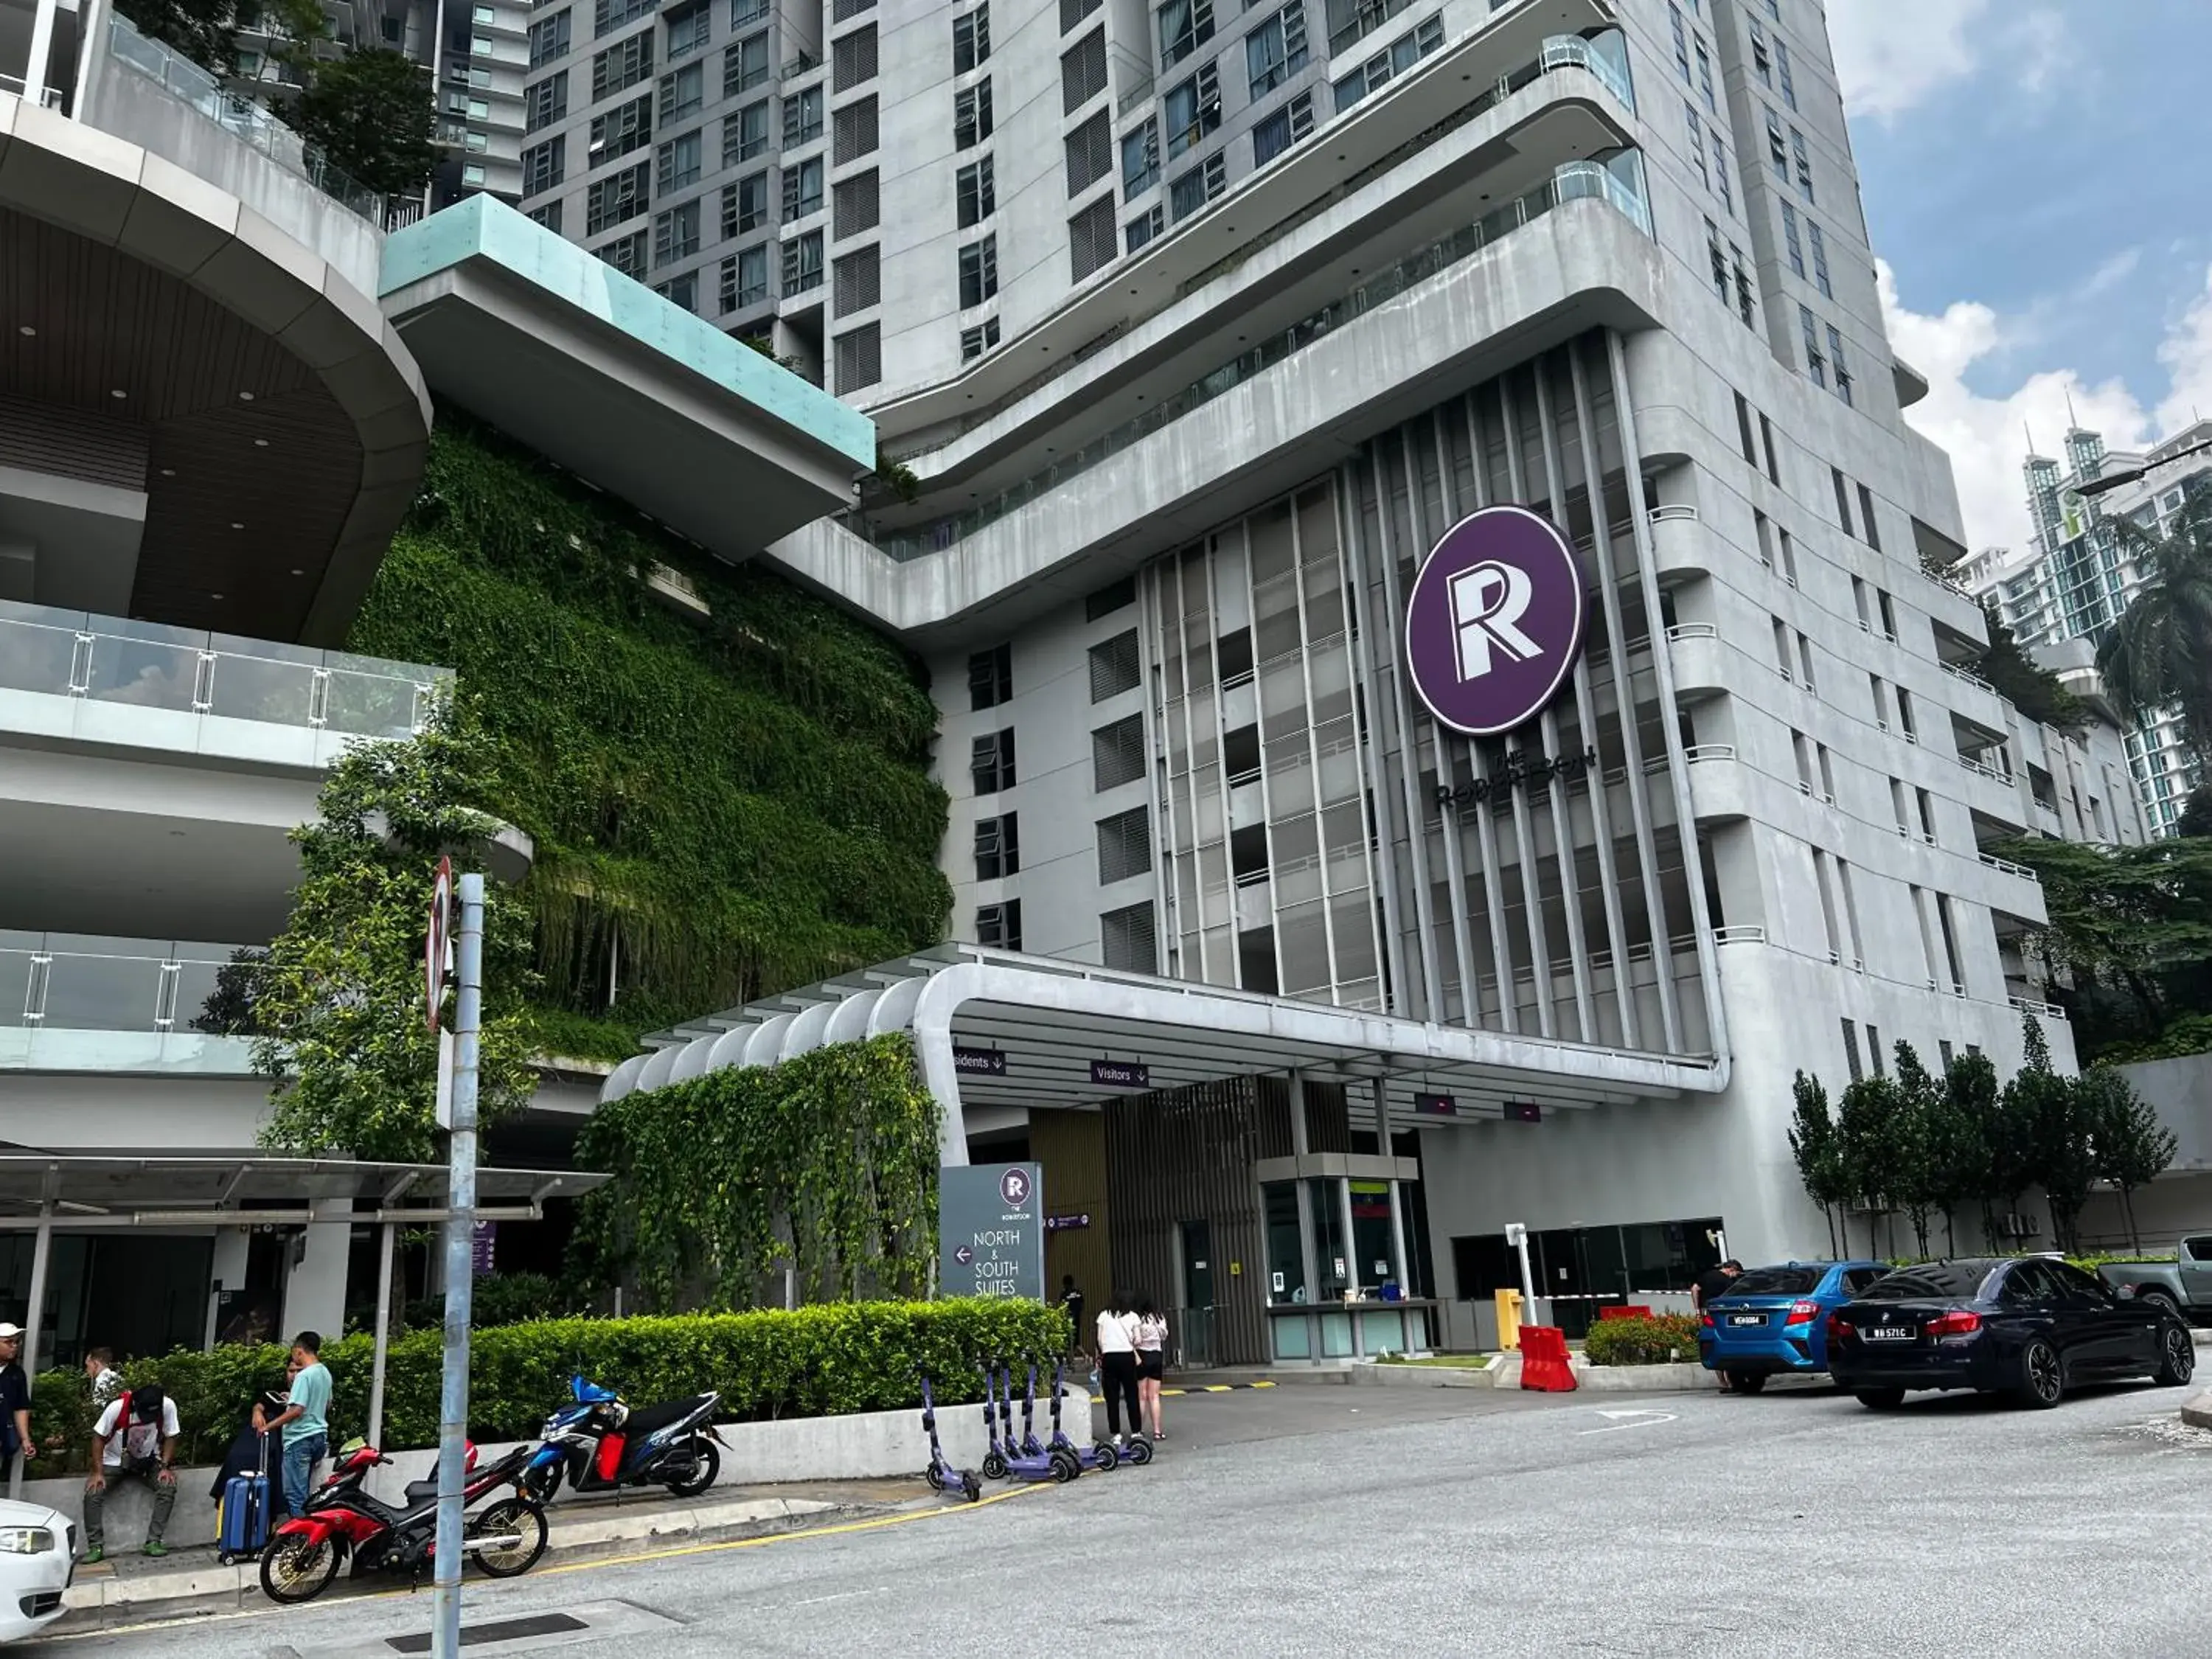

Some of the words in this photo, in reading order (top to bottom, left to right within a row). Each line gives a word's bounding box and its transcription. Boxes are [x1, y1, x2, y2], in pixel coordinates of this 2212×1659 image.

[1446, 560, 1544, 684] R
[955, 1054, 989, 1068] sidents
[1097, 1066, 1130, 1080] Visitors
[1007, 1176, 1023, 1197] R
[974, 1230, 1020, 1247] NORTH
[991, 1250, 998, 1260] &
[975, 1260, 1019, 1278] SOUTH
[975, 1279, 1015, 1296] SUITES
